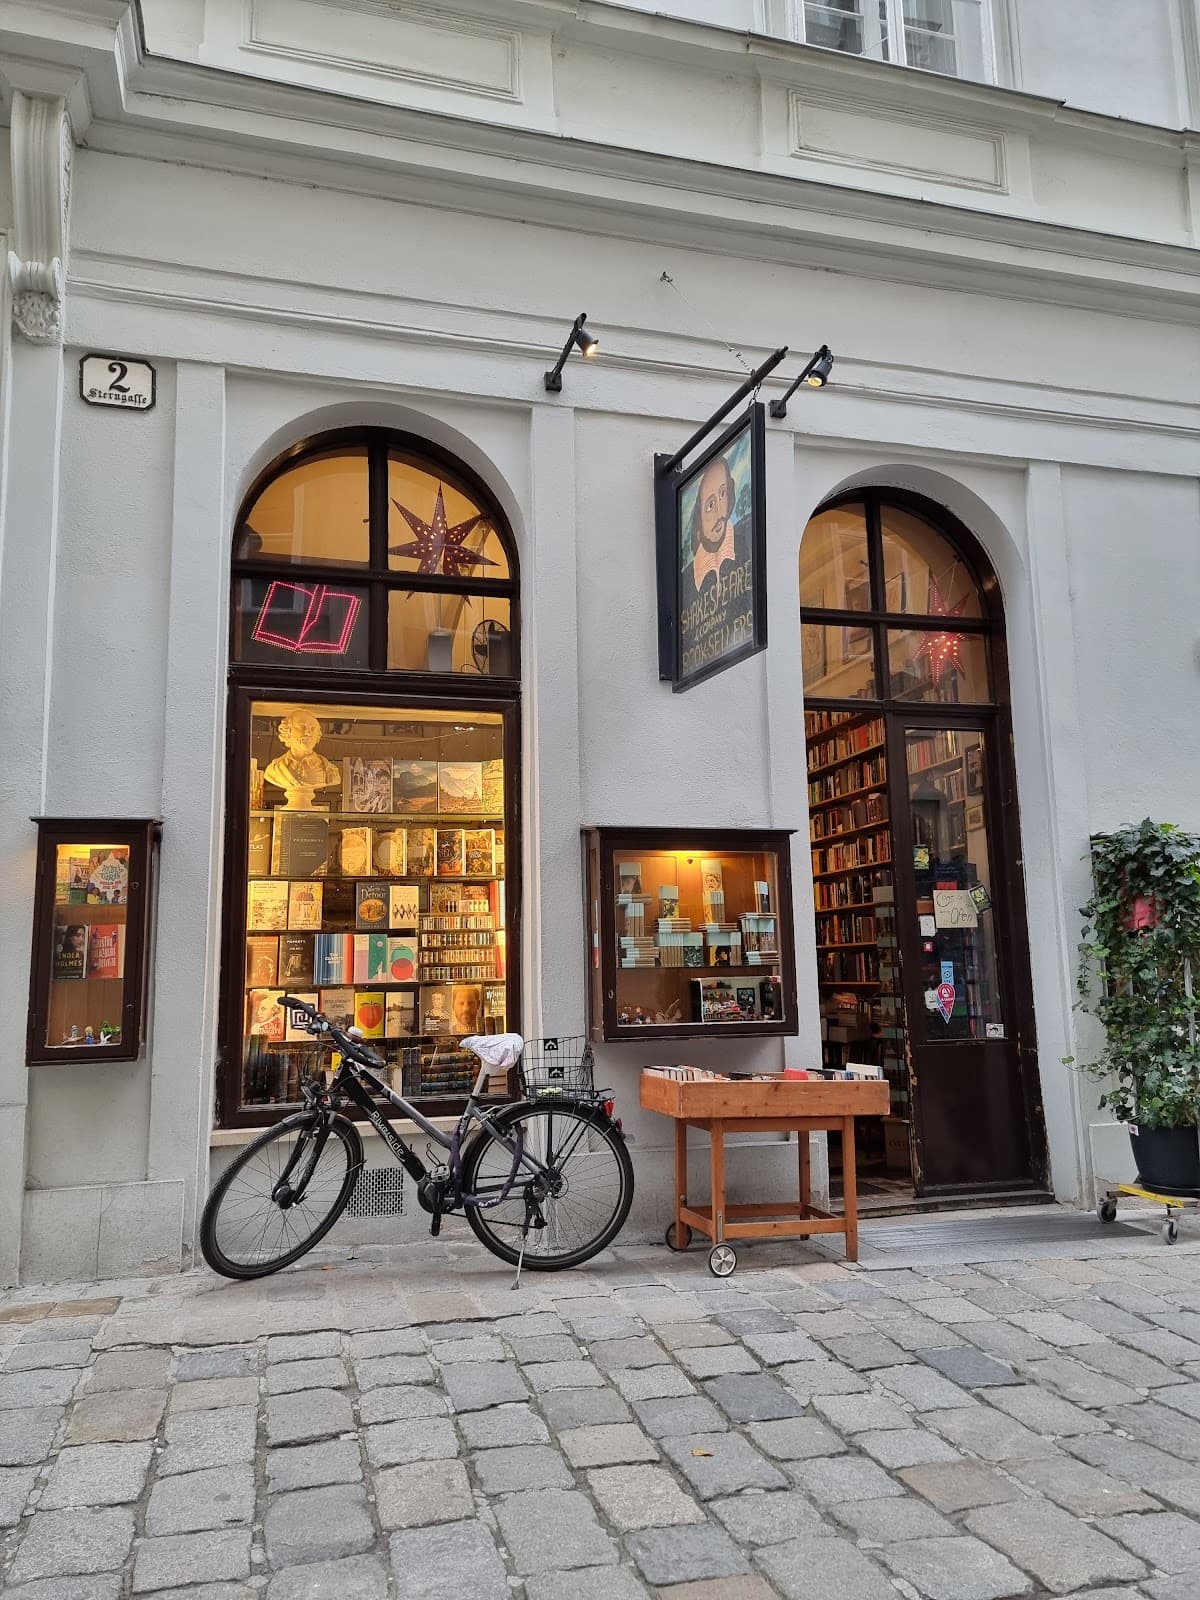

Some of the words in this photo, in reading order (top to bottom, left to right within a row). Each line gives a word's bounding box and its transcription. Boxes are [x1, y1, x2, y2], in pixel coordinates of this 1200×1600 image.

[108, 362, 131, 393] 2
[681, 559, 752, 635] SHAKESPEARE
[682, 609, 753, 673] BOOKSELLERS
[700, 609, 727, 638] COMPANY
[370, 1110, 405, 1158] Riverside
